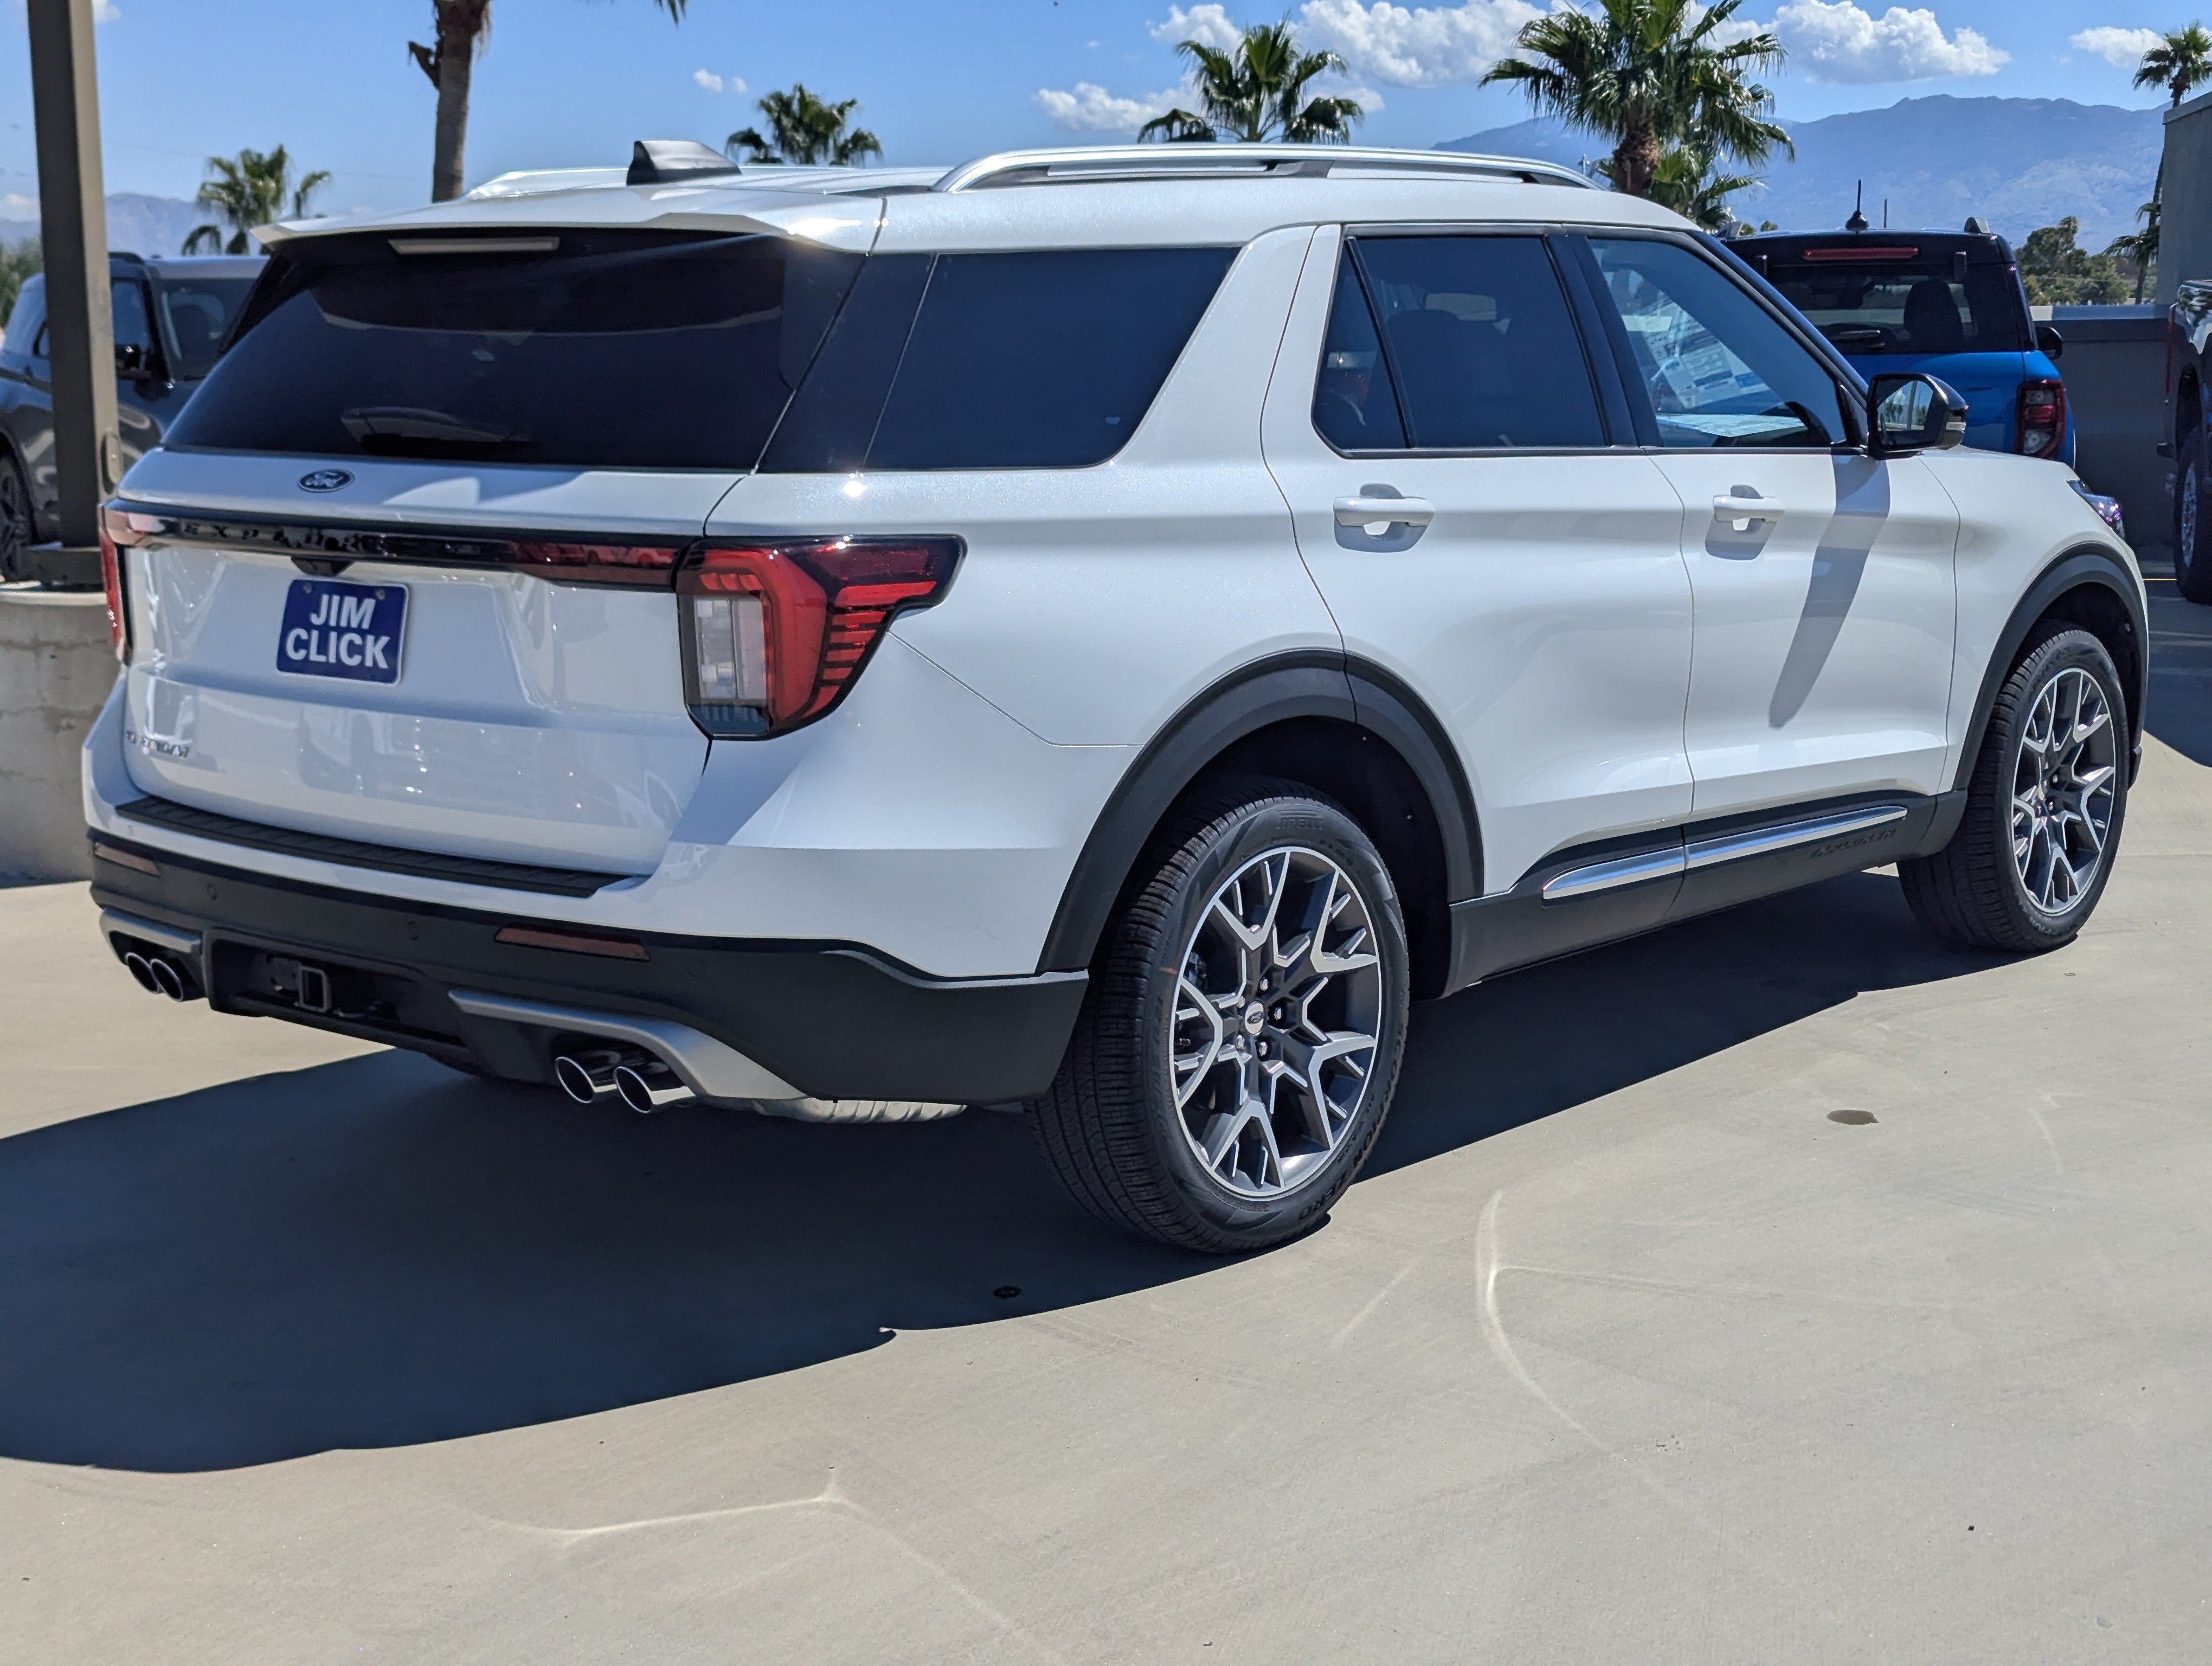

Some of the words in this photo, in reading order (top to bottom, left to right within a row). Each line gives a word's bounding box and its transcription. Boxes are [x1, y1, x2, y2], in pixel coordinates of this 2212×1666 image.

[305, 472, 344, 487] Ford
[309, 594, 376, 630] JIM
[286, 627, 390, 669] CLICK
